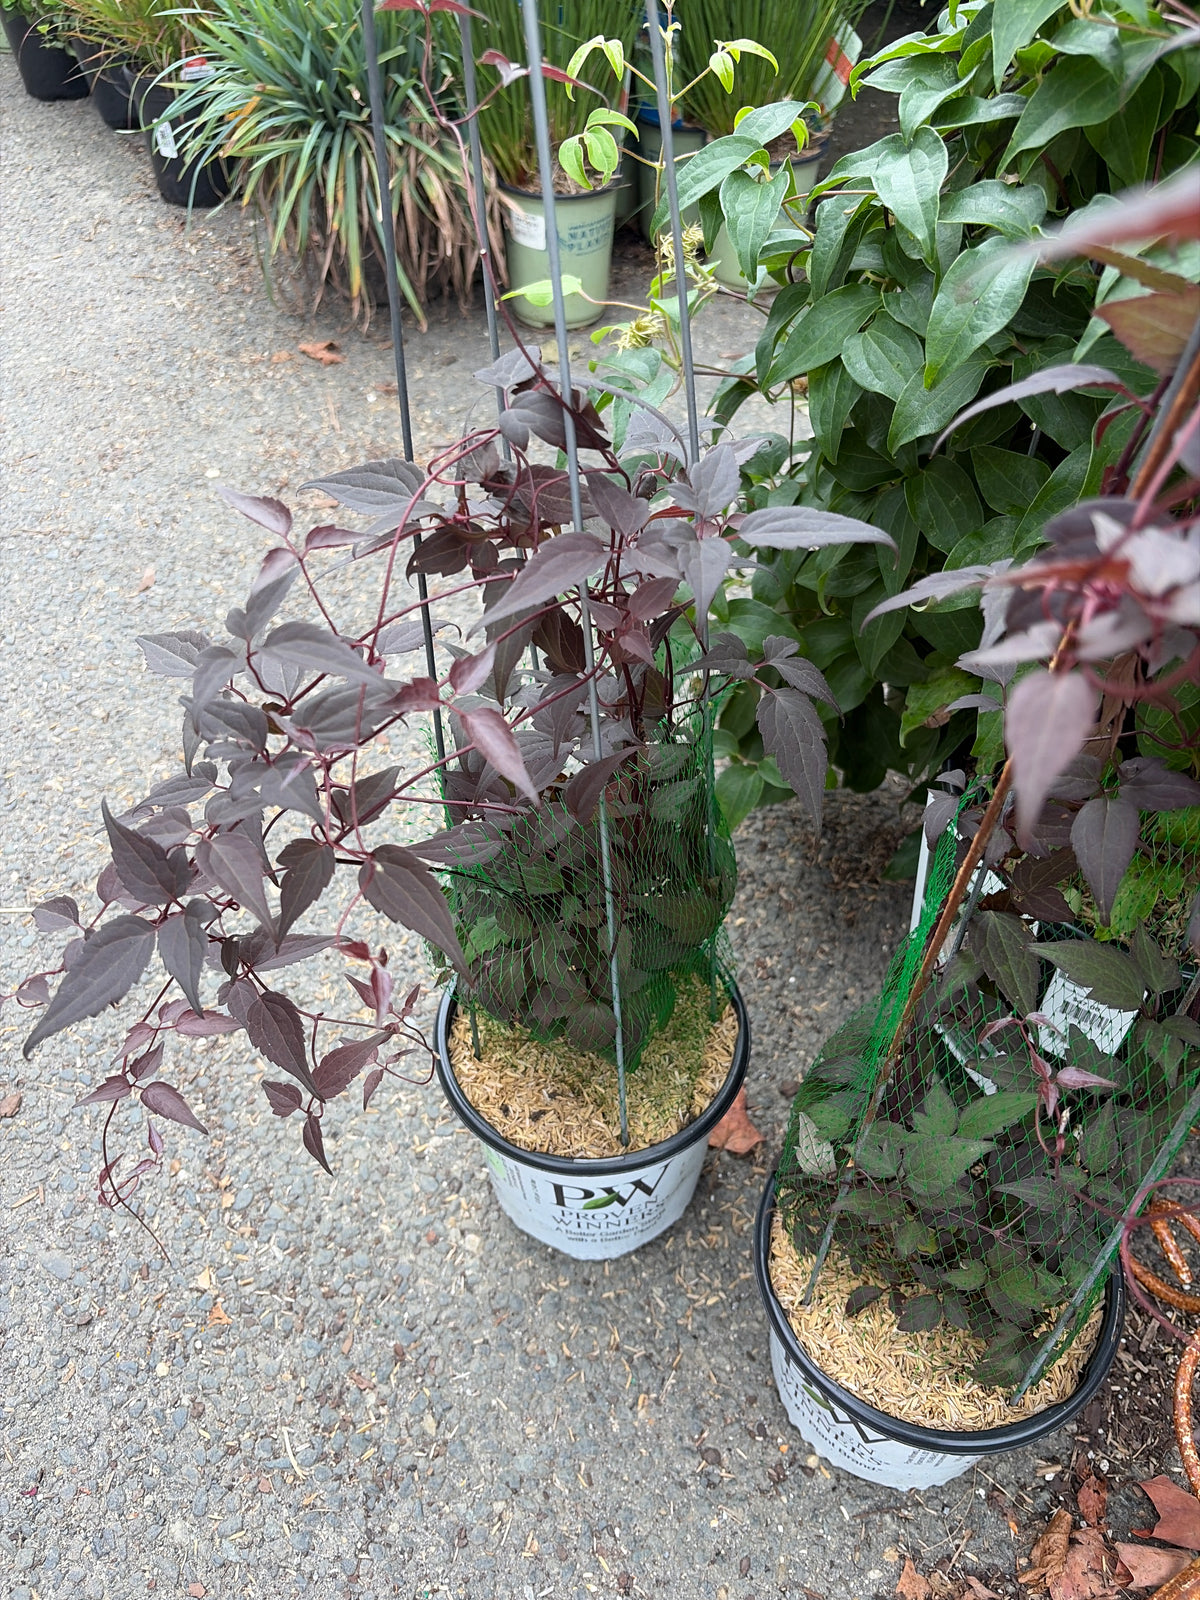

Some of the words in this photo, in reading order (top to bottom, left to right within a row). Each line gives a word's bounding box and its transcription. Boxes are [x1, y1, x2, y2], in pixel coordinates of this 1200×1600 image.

[545, 1159, 673, 1210] PW
[551, 1201, 666, 1230] WINNERS
[560, 1195, 658, 1221] PROVEN
[564, 1228, 597, 1238] Better
[599, 1224, 639, 1238] Garden
[566, 1235, 588, 1243] with
[785, 1366, 875, 1456] PROVEN
